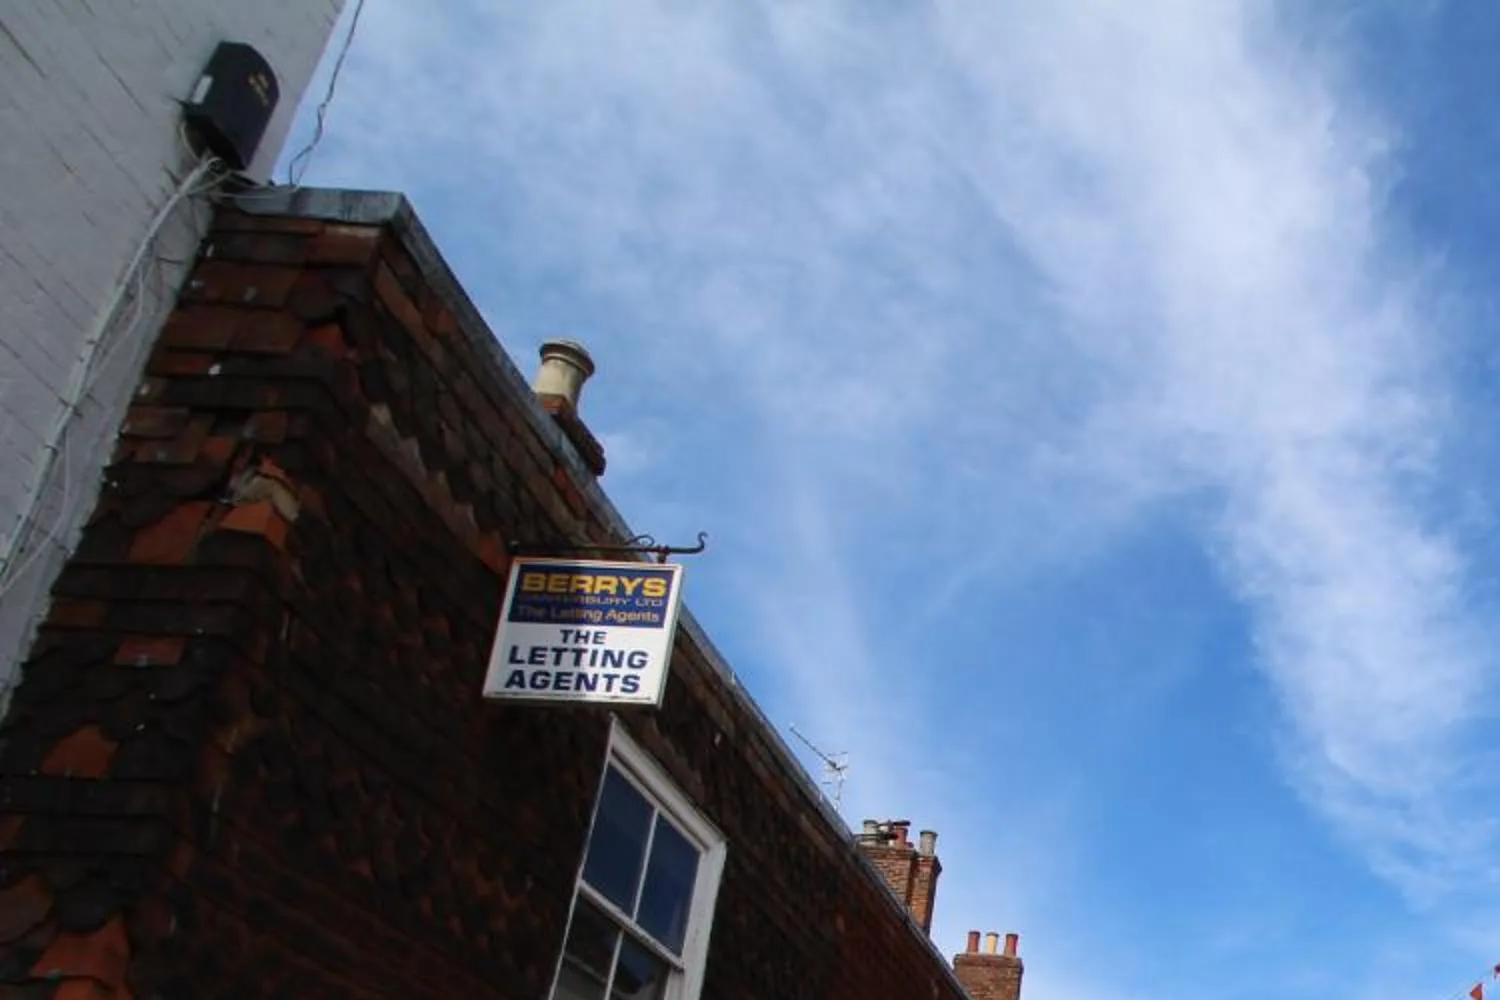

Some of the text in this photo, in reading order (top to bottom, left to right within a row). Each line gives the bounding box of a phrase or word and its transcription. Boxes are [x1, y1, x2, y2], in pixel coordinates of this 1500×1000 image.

[521, 572, 667, 597] BERRYS
[605, 608, 660, 624] Agents
[560, 629, 607, 644] THE
[507, 645, 649, 669] LETTING
[504, 669, 641, 693] AGENTS
